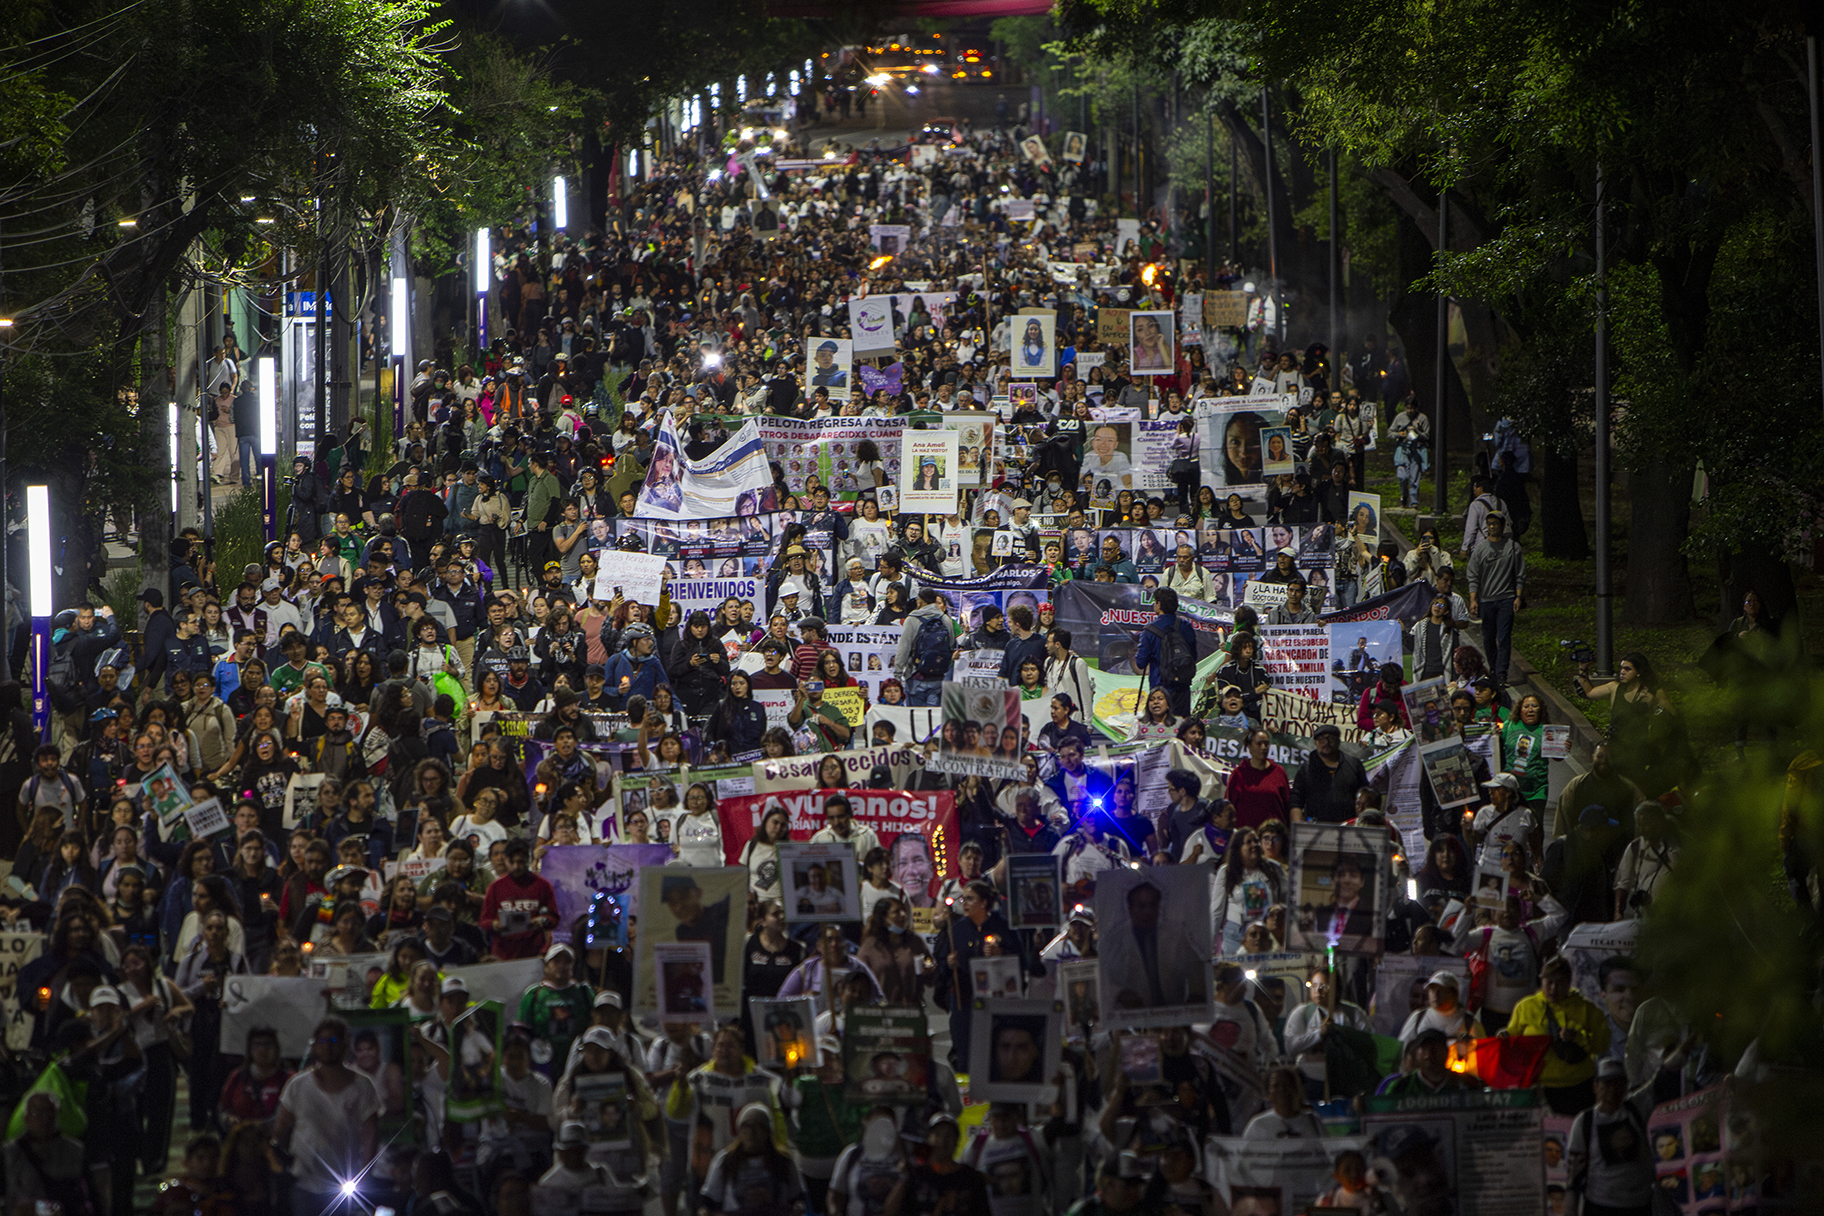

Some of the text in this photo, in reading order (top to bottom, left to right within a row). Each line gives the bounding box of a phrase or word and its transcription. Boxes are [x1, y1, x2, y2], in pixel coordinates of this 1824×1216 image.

[761, 417, 907, 429] PELOTA REGRESA A CASA
[759, 429, 902, 440] STROS DESAPARECIDXS CUÁND
[666, 580, 755, 599] BIENVENIDOS
[1178, 602, 1217, 618] LOTA
[1100, 608, 1158, 625] ¿NUEST
[1294, 638, 1329, 647] ESCOBEDO
[1319, 649, 1329, 659] DE
[1265, 662, 1325, 673] UESTRA AMILIA
[962, 677, 1008, 689] HASTA
[1275, 675, 1325, 685] NO DE NUESTRO
[1265, 693, 1358, 724] EN LUCHA PO
[926, 759, 1027, 779] ENCONTRARLOS
[750, 791, 938, 827] ¡Ayúanos!
[882, 822, 921, 833] HIJOS
